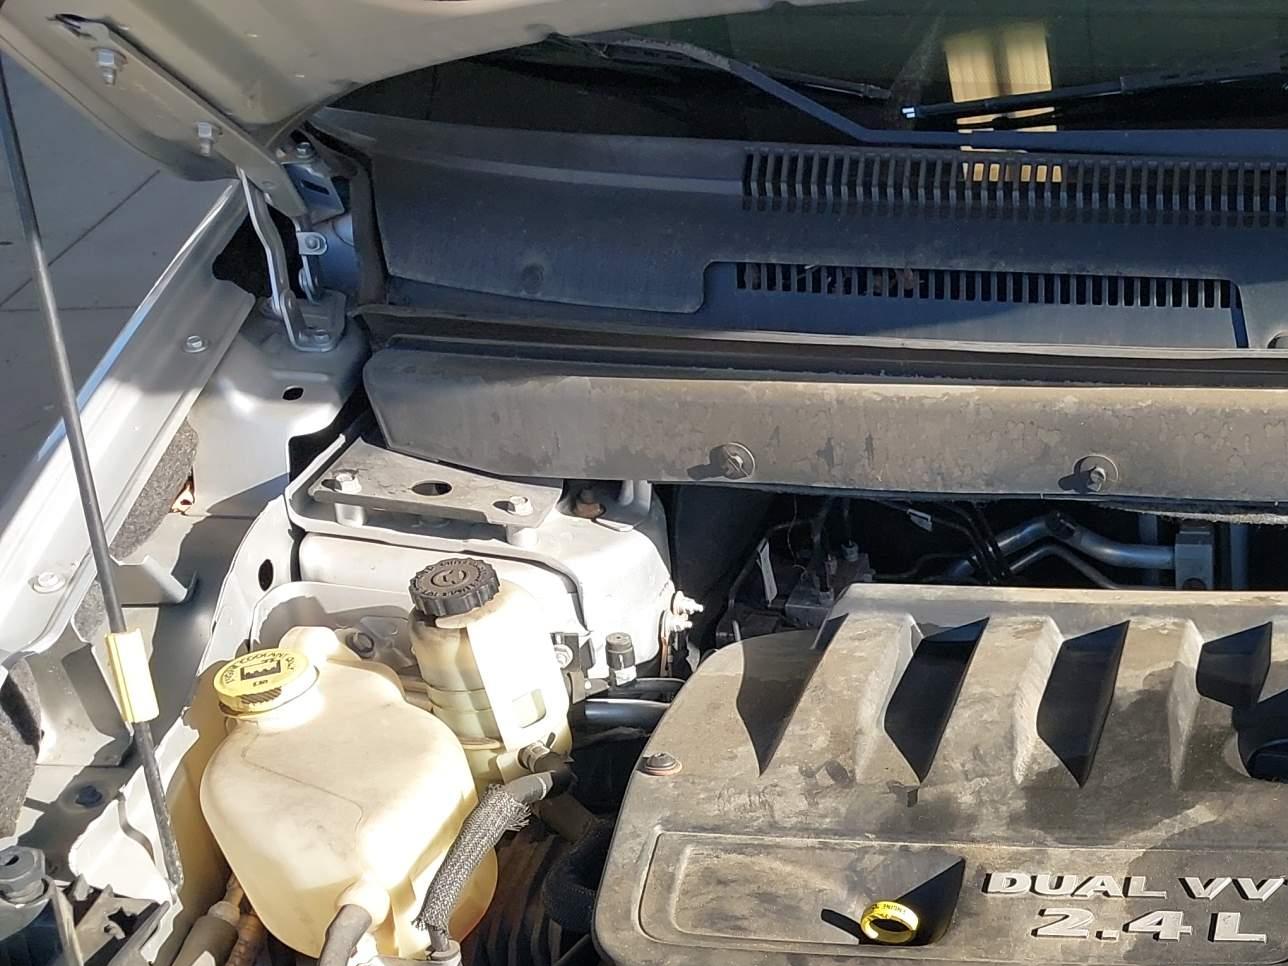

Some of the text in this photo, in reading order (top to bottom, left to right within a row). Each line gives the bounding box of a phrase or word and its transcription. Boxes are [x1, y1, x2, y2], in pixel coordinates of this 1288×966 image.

[984, 872, 1167, 899] DUAL
[1031, 907, 1267, 943] 2.4 L
